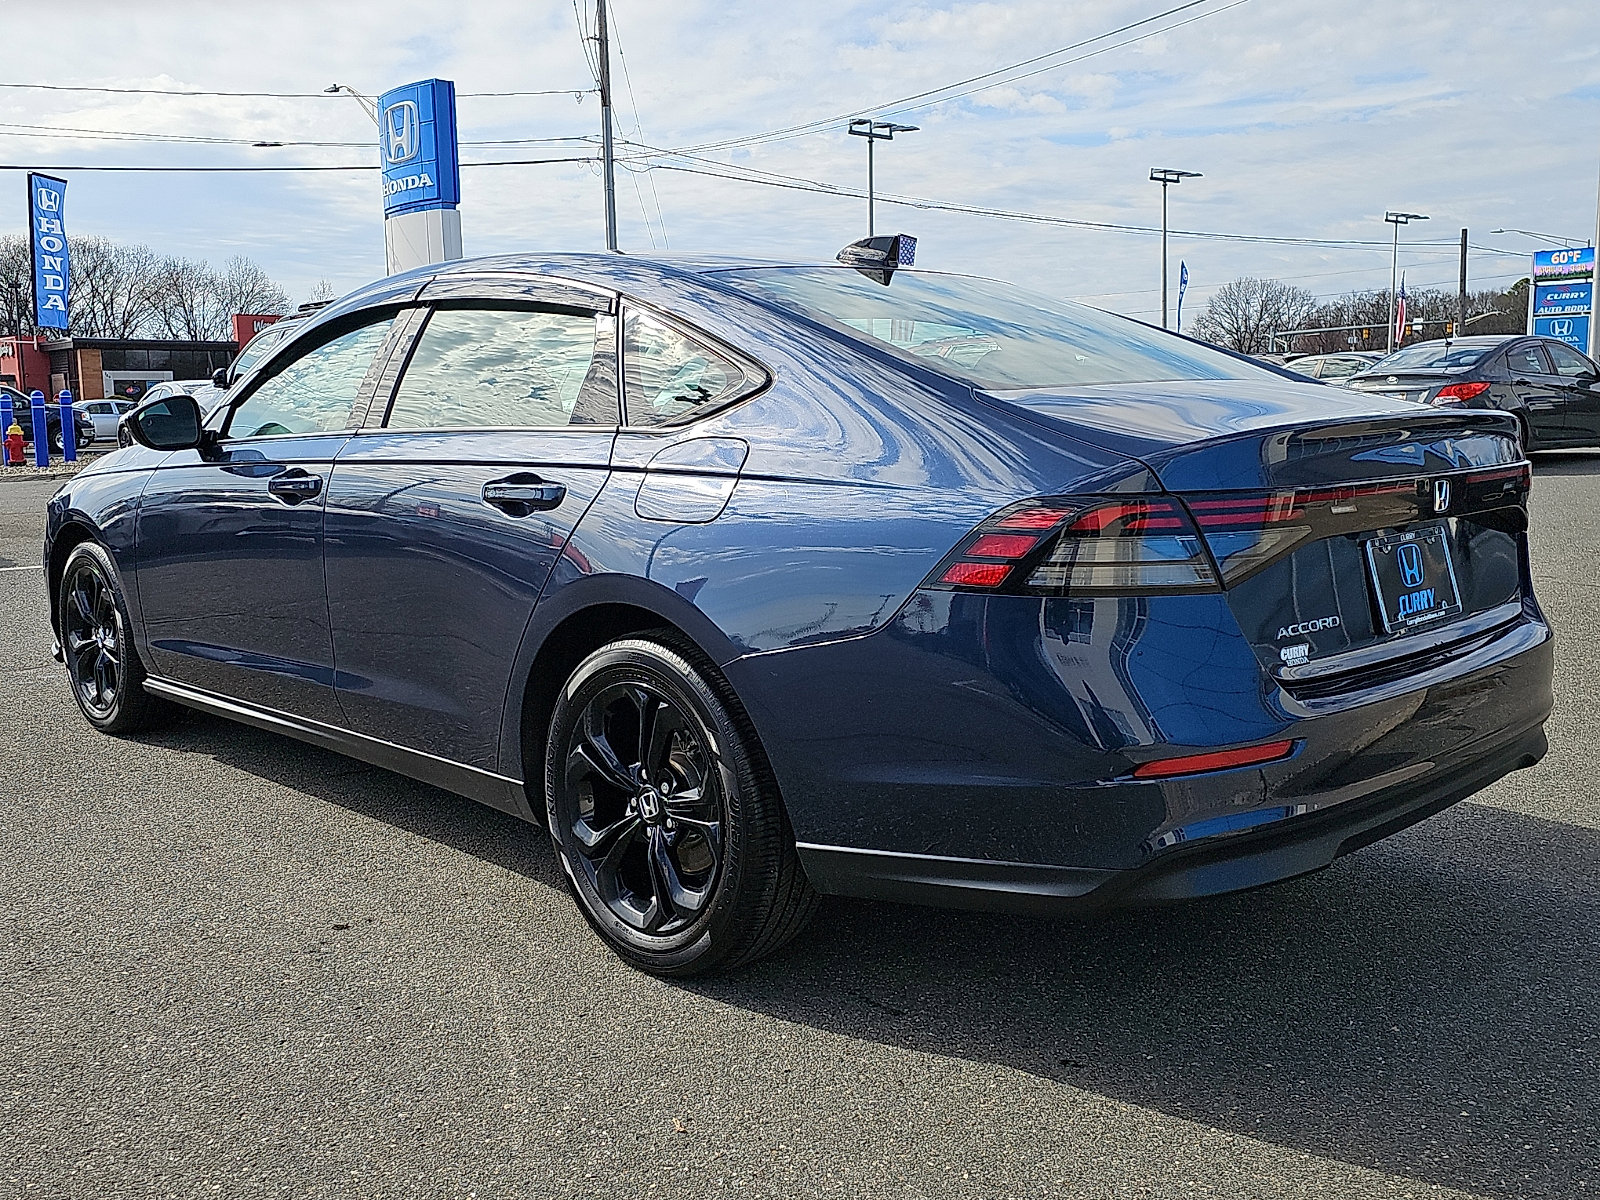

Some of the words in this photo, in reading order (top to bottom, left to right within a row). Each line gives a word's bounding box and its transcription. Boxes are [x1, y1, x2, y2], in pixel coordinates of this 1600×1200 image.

[382, 173, 435, 197] HONDA
[38, 216, 66, 311] HONDA
[1551, 250, 1582, 264] 60°F
[1546, 292, 1588, 300] CURRY
[1538, 306, 1562, 314] AUTO
[1564, 304, 1590, 312] BODY
[1399, 588, 1435, 615] CURRY
[1276, 616, 1340, 640] ACCORD
[1280, 643, 1309, 661] CURRY
[1286, 656, 1310, 667] HONDA
